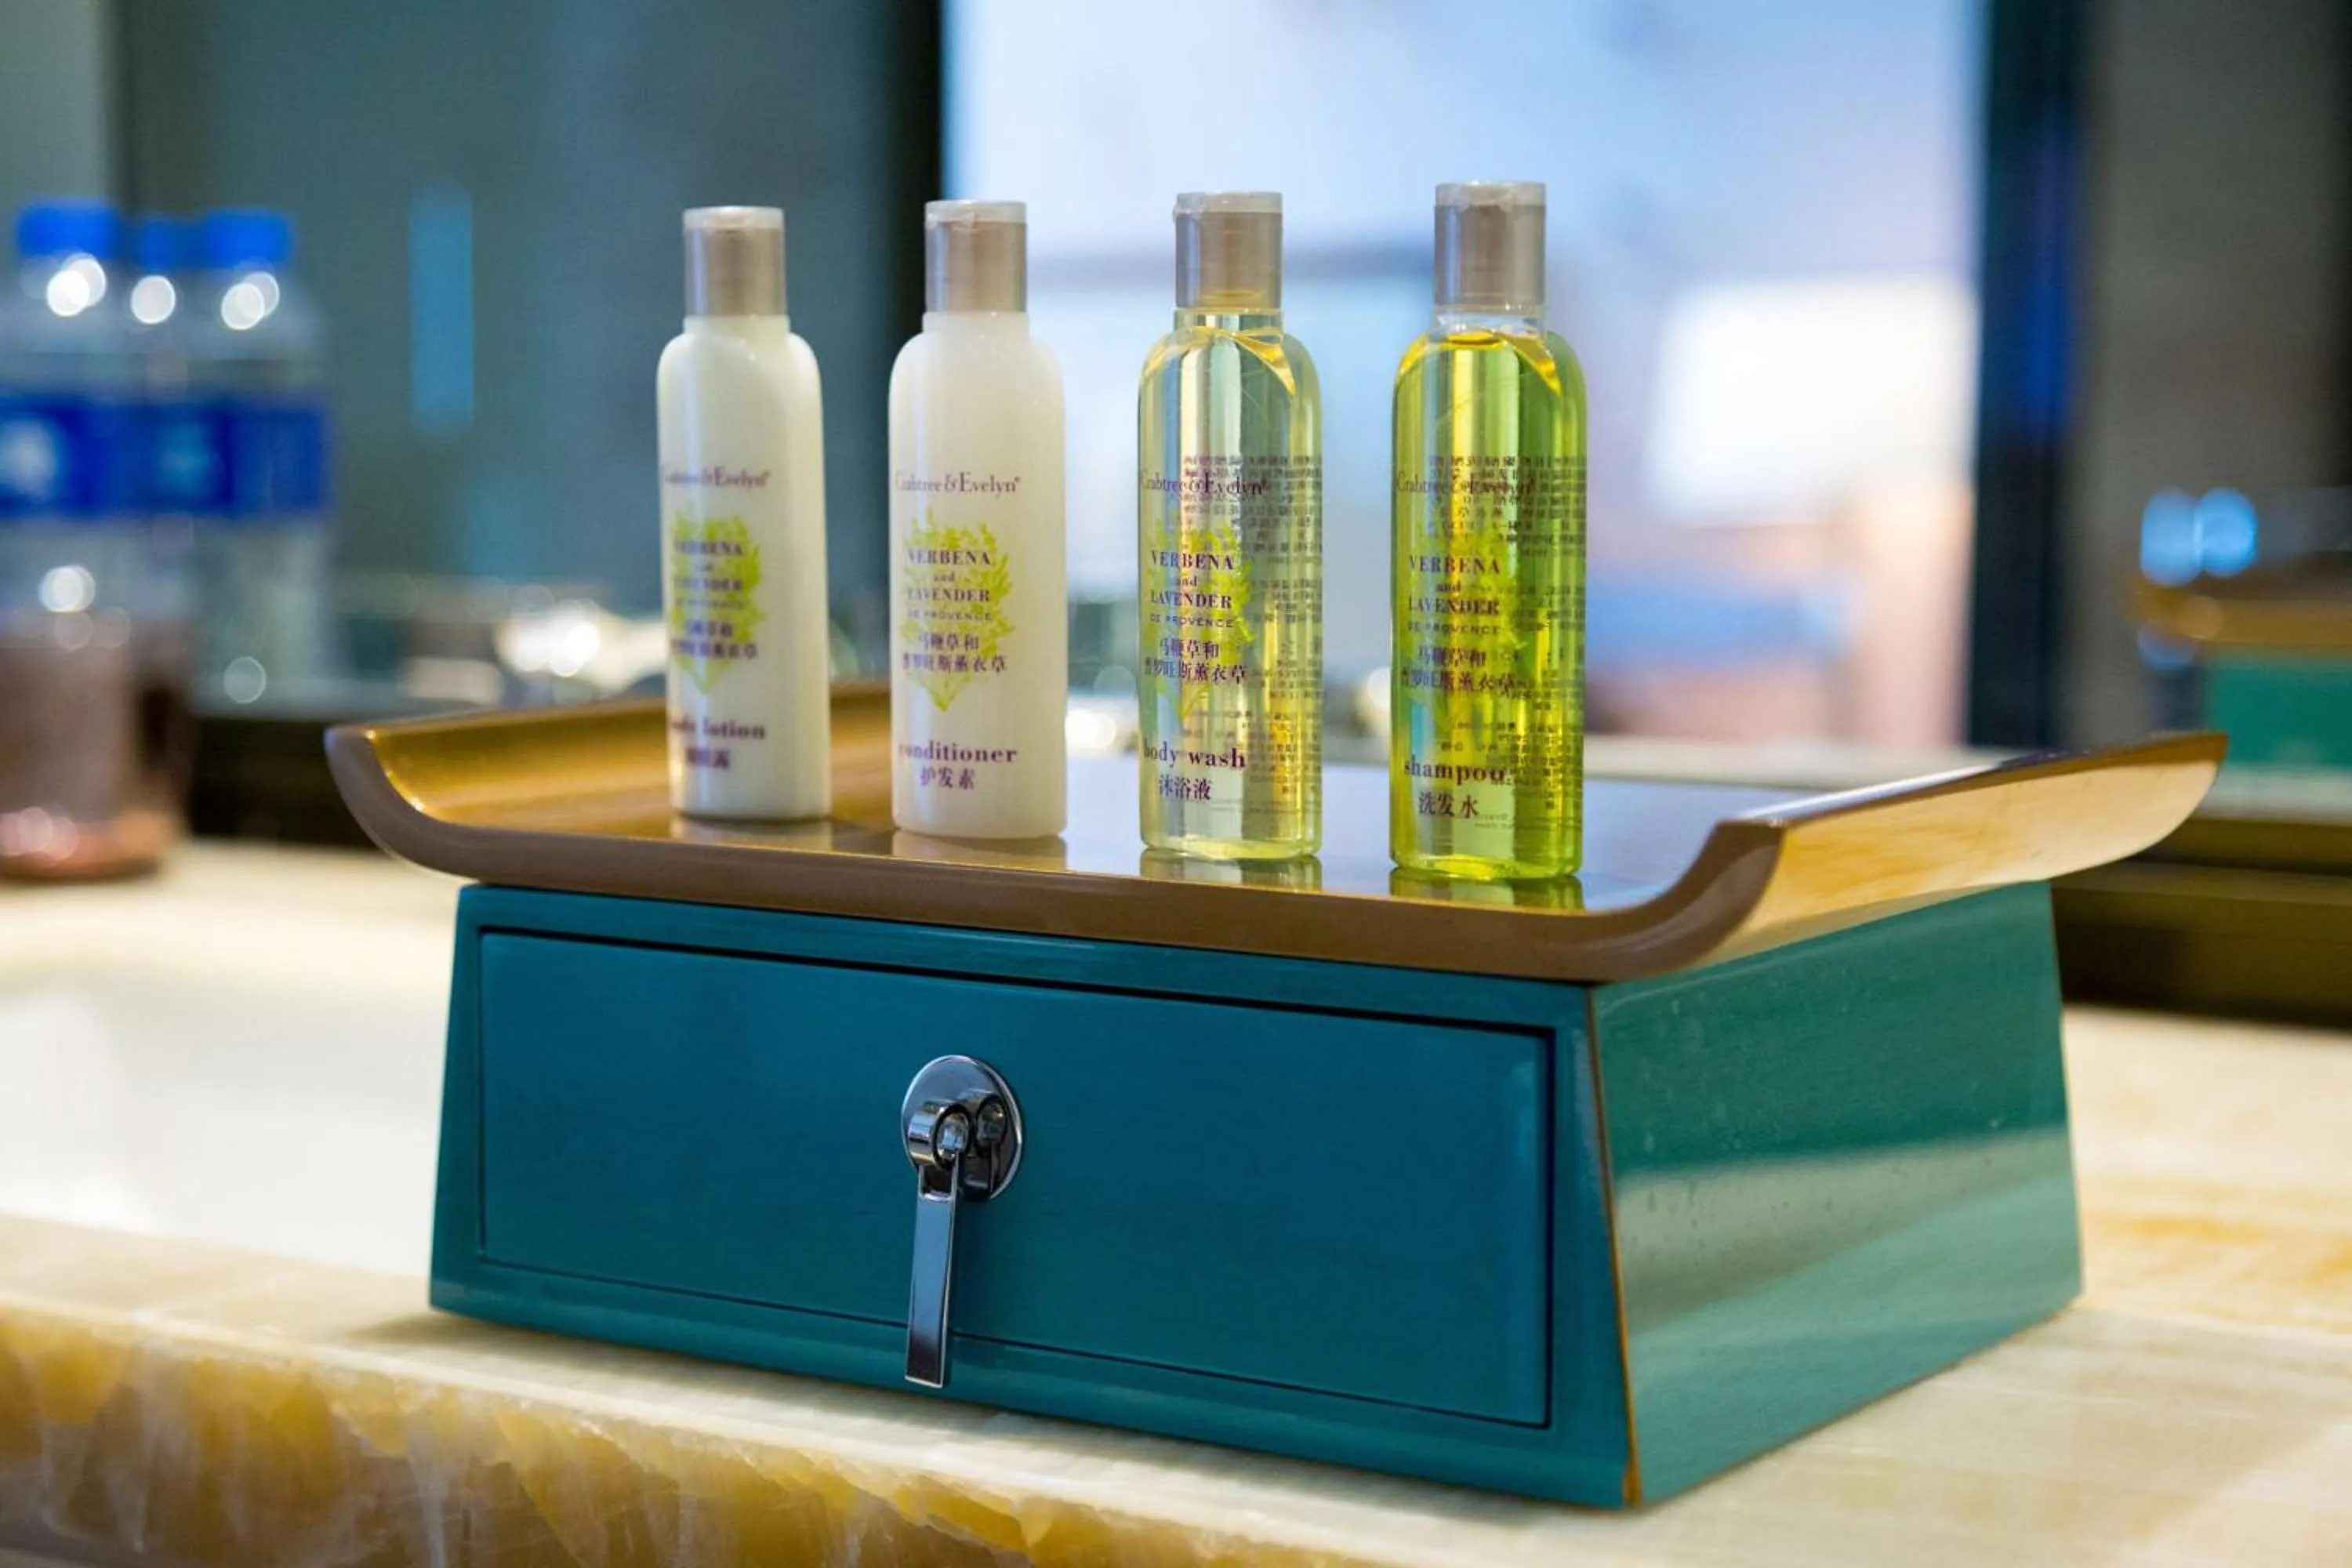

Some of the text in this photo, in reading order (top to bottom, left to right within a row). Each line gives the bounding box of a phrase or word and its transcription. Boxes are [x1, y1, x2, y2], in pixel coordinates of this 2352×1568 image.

[907, 550, 991, 565] VERBENA
[1150, 550, 1234, 570] VERBENA
[1409, 554, 1501, 575] VERBENA
[933, 571, 956, 583] and
[1176, 575, 1198, 587] and
[907, 588, 991, 603] LAVENDER
[1436, 581, 1462, 593] and
[1150, 590, 1232, 609] LAVENDER
[1408, 597, 1500, 616] LAVENDER
[1166, 615, 1235, 628] PROVENCE
[1160, 637, 1220, 659] 马鞭草和
[702, 719, 766, 740] lotion
[1143, 738, 1247, 768] body wash
[920, 766, 976, 791] 护发素
[1158, 774, 1212, 800] 沐浴液
[1417, 792, 1479, 819] 洗发水
